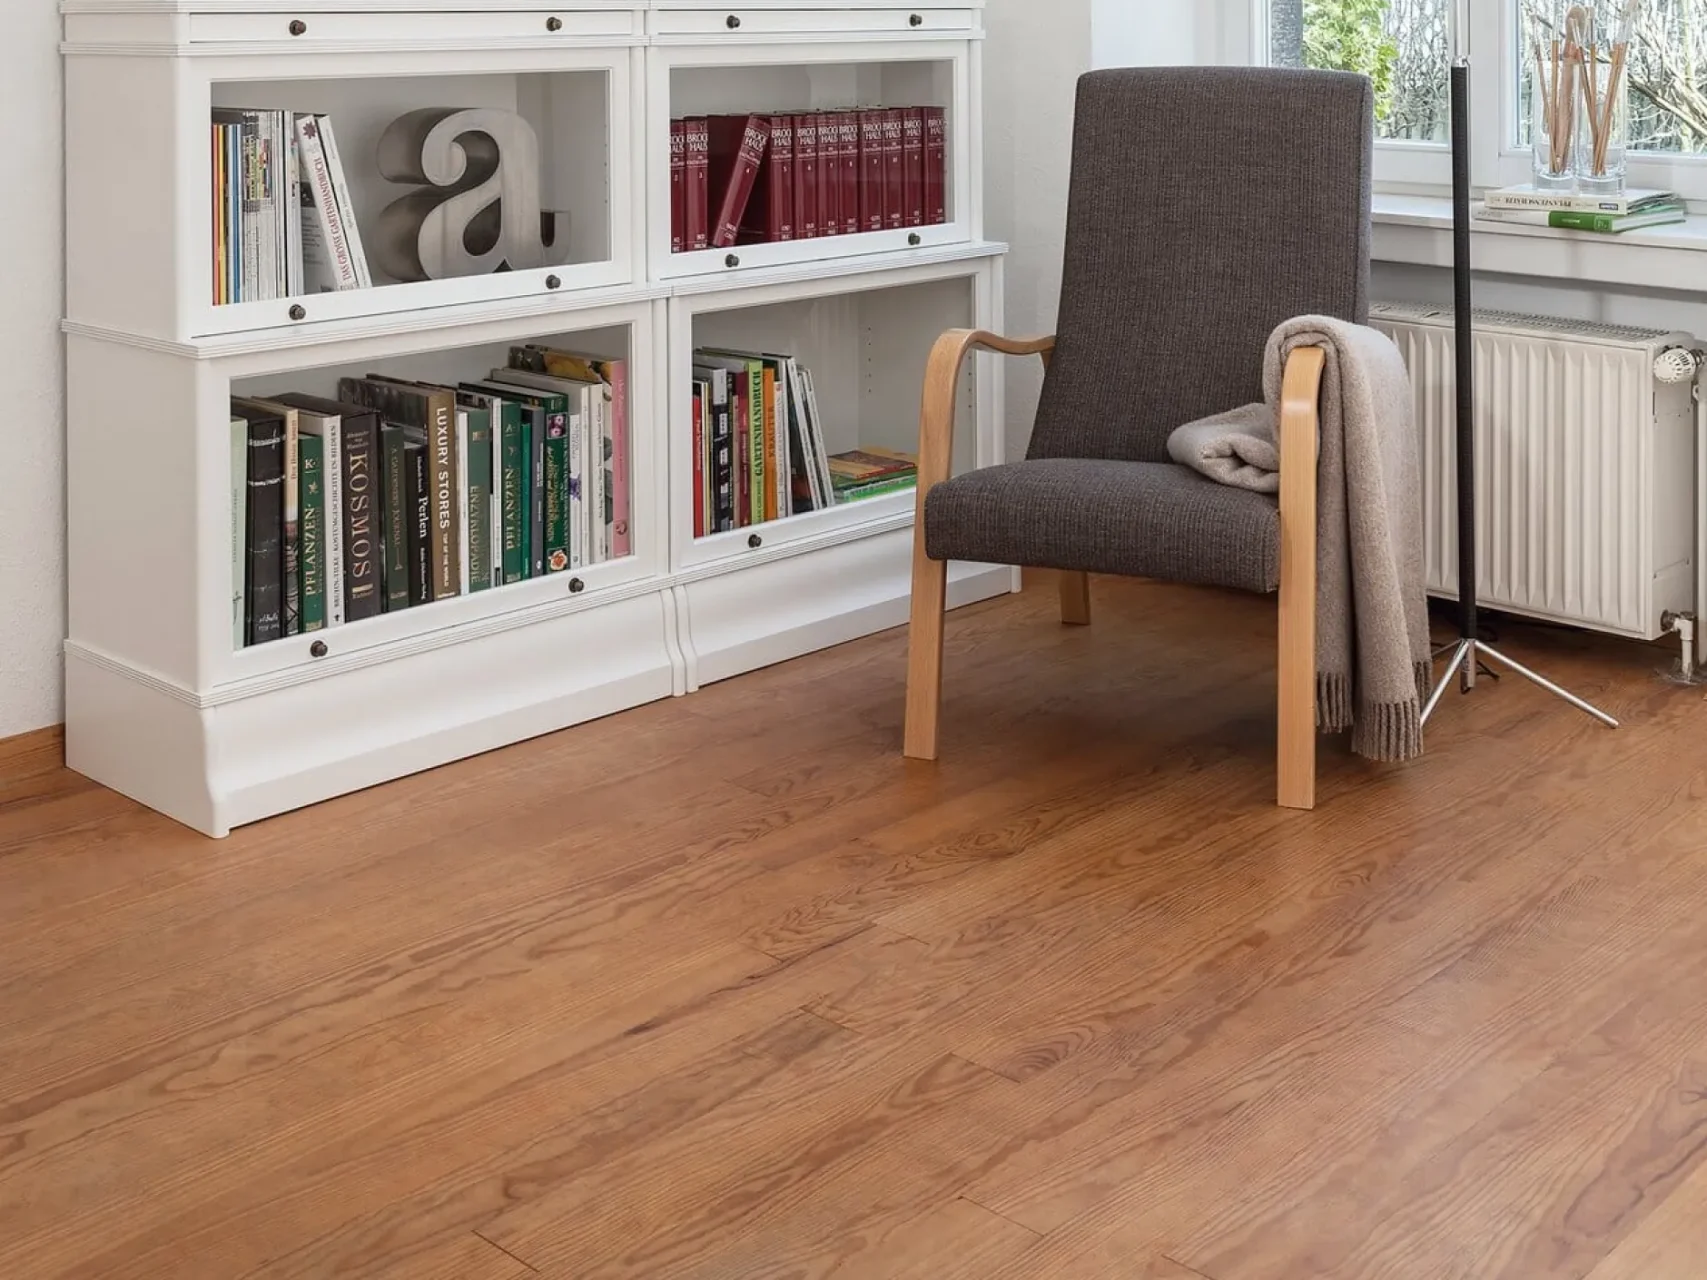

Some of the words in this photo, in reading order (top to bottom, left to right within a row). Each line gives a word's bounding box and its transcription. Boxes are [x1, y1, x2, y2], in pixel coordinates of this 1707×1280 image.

[392, 107, 571, 282] a
[436, 407, 448, 465] LUXURY
[753, 370, 763, 477] GARTENHANDBUCH
[350, 454, 371, 578] KOSMOS
[418, 496, 430, 538] Perlen
[438, 471, 450, 529] STORES
[305, 506, 317, 596] PFLANZEN
